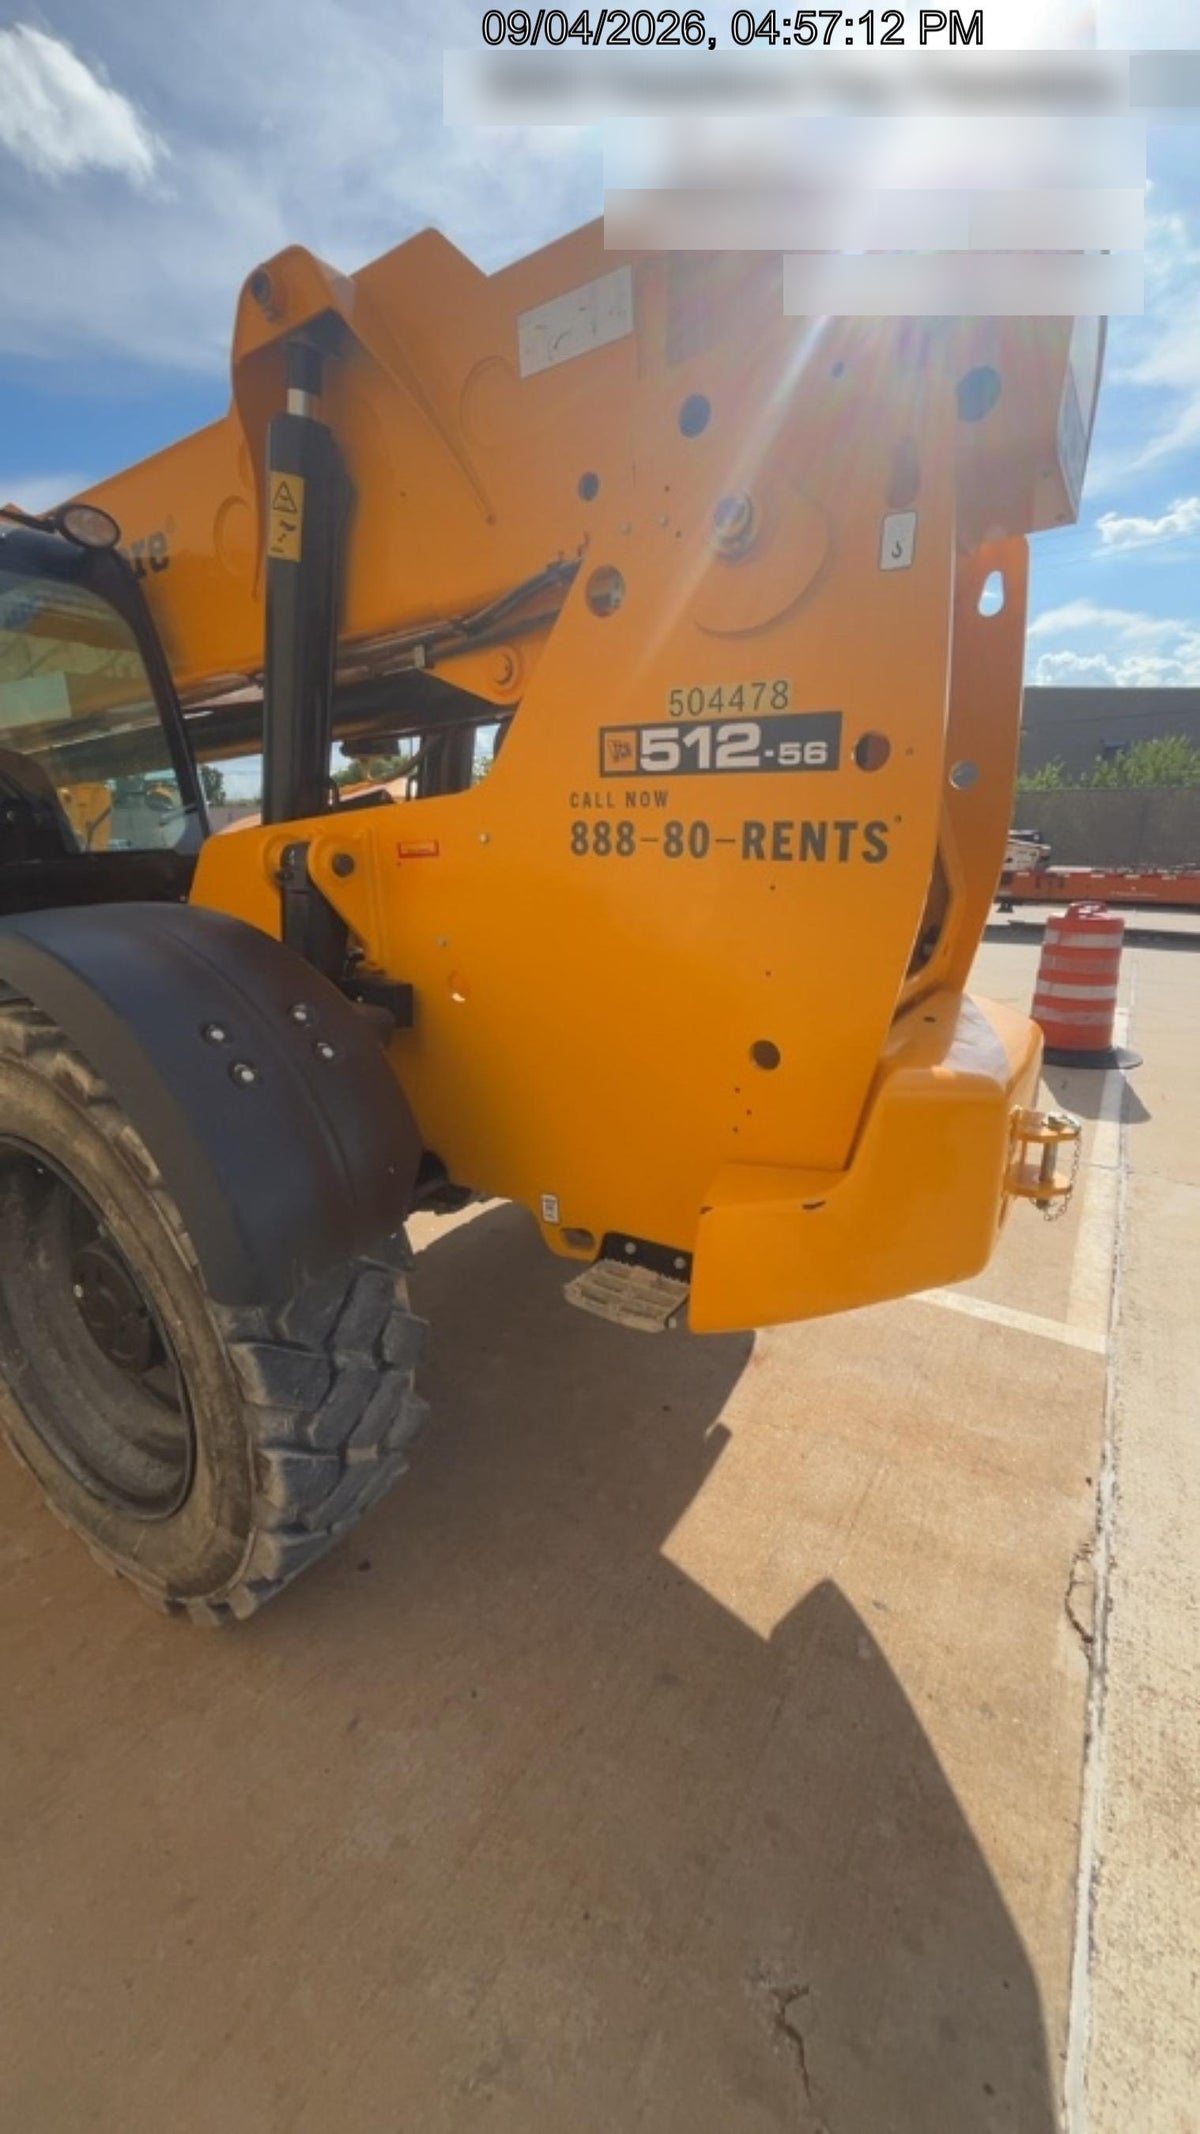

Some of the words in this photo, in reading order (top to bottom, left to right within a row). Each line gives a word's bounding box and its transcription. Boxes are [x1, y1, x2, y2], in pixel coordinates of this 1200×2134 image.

[668, 679, 790, 717] 504478
[569, 791, 615, 809] CALL
[625, 790, 670, 808] NOW
[570, 819, 890, 864] 888-80-RENTS
